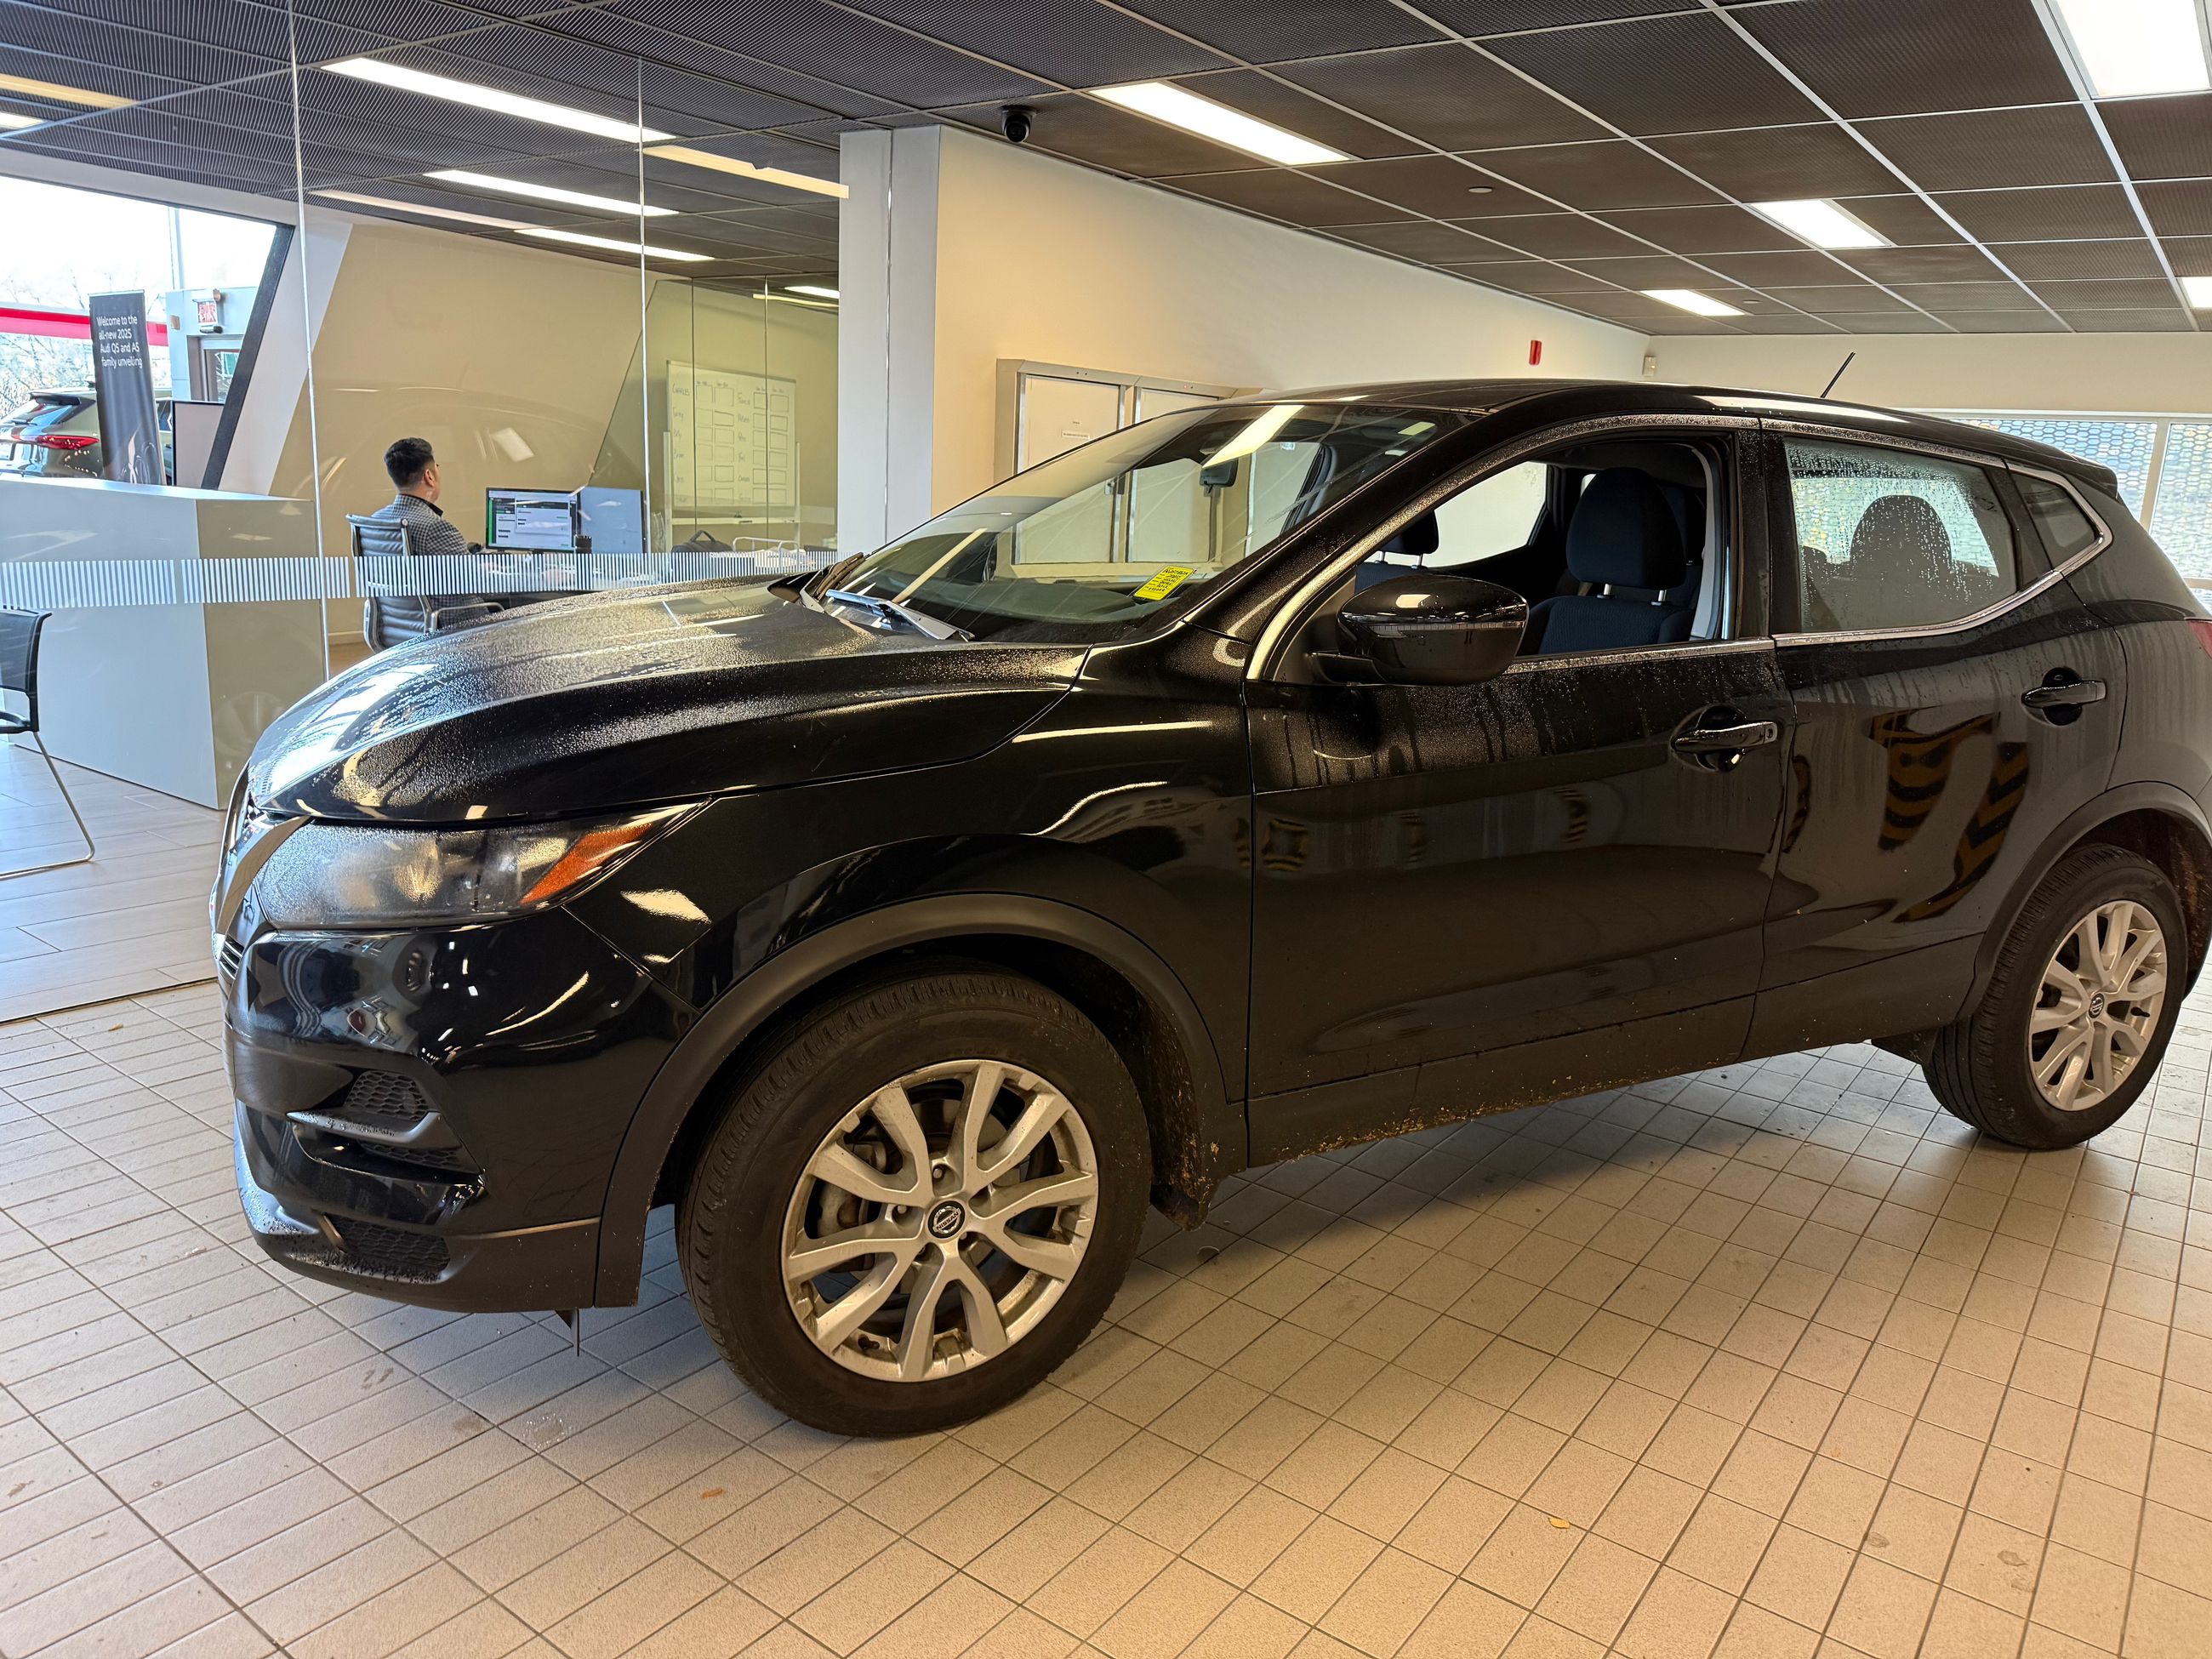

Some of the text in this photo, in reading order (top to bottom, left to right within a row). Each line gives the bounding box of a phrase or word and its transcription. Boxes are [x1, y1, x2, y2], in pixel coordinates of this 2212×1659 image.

[96, 314, 138, 327] Welcome to the
[99, 328, 132, 340] all-new 2025
[100, 341, 140, 354] Audi Q5 and A5
[101, 356, 143, 369] family unveiling
[936, 1211, 959, 1230] NISSAN
